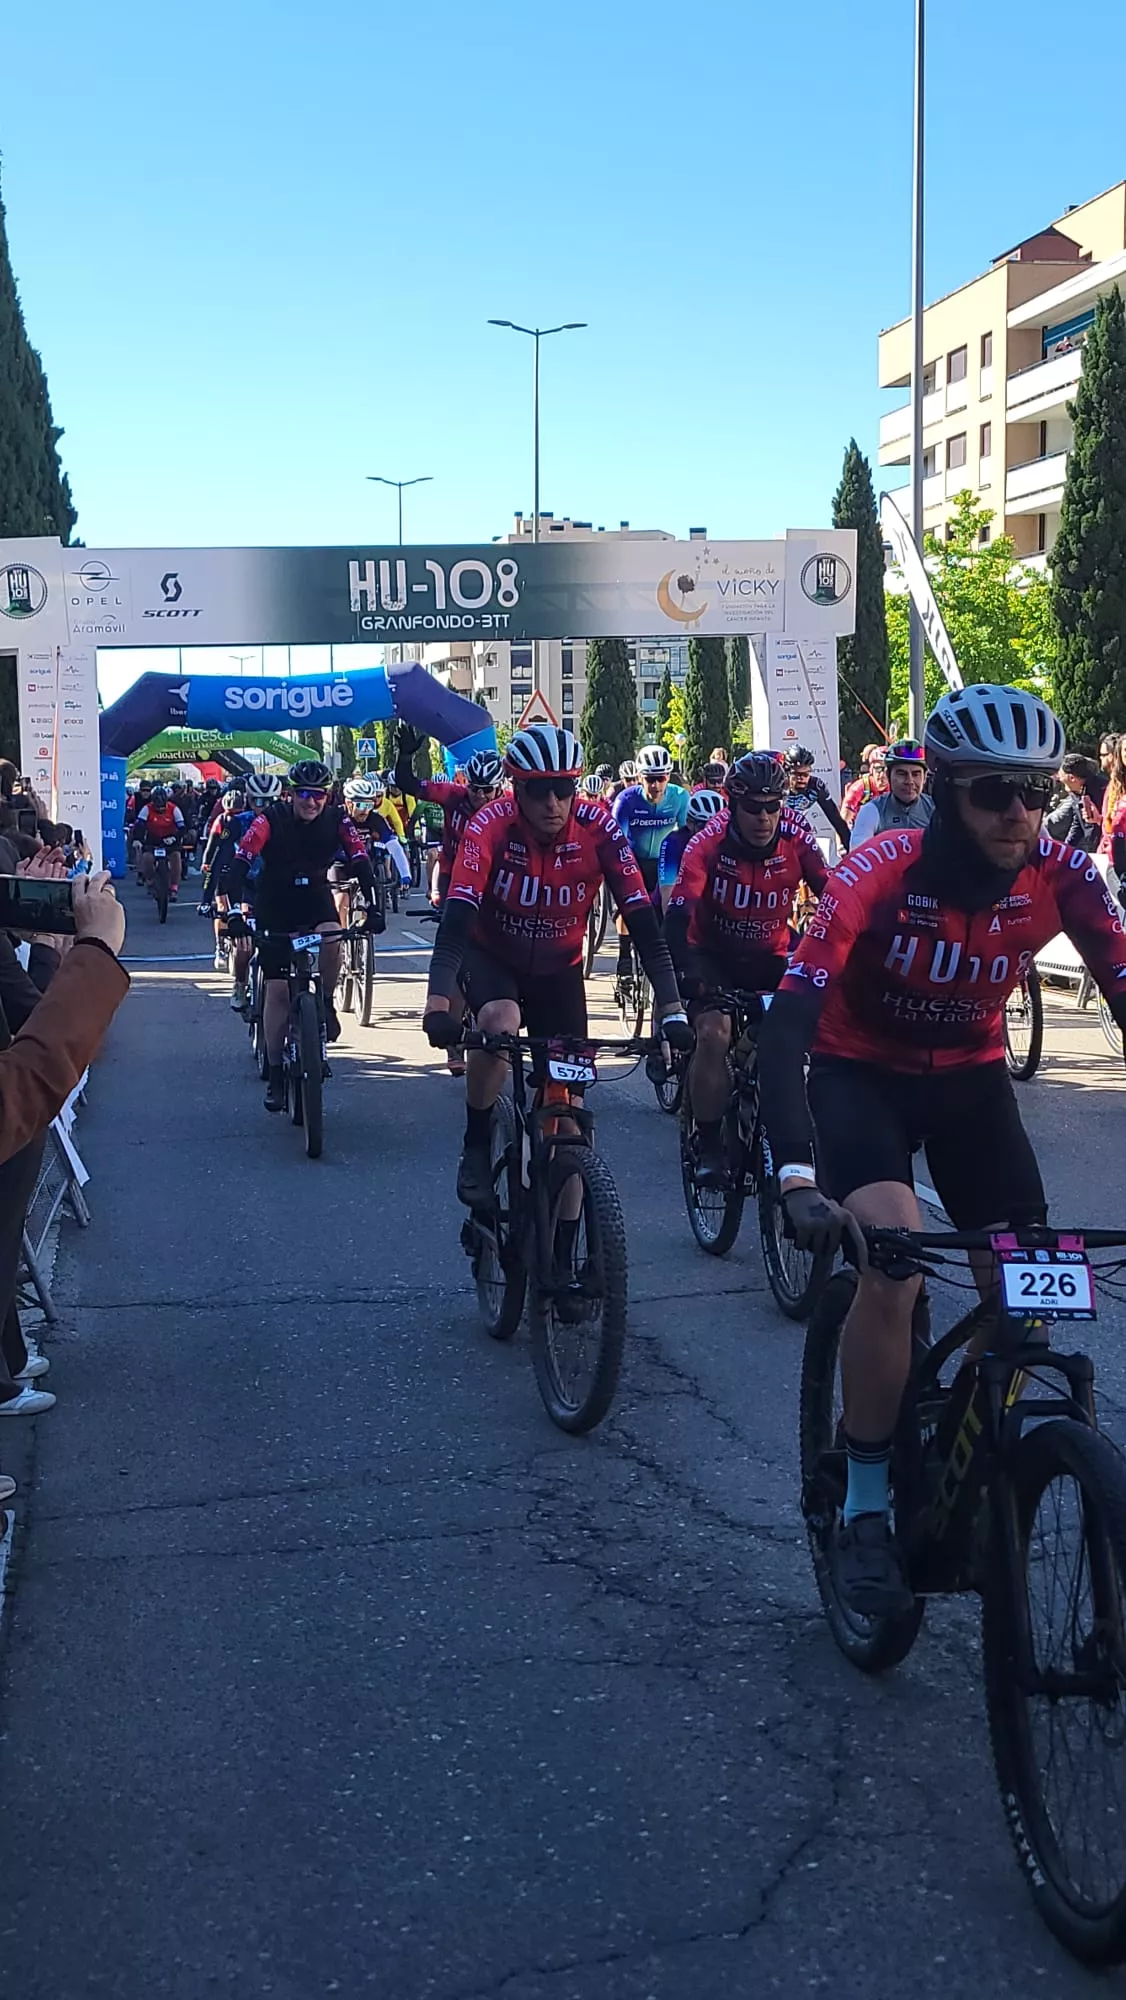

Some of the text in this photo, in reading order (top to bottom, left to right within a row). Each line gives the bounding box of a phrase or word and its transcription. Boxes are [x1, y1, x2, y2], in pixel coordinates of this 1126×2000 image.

[349, 558, 519, 611] HU-108
[71, 597, 122, 605] OPEL
[142, 609, 204, 618] SCOTT
[153, 750, 197, 760] doactiva
[640, 817, 677, 826] DECATHLO
[1039, 838, 1099, 882] U108
[907, 893, 939, 910] GOBIK
[1019, 1271, 1077, 1297] 226
[930, 1382, 984, 1542] SCOT
